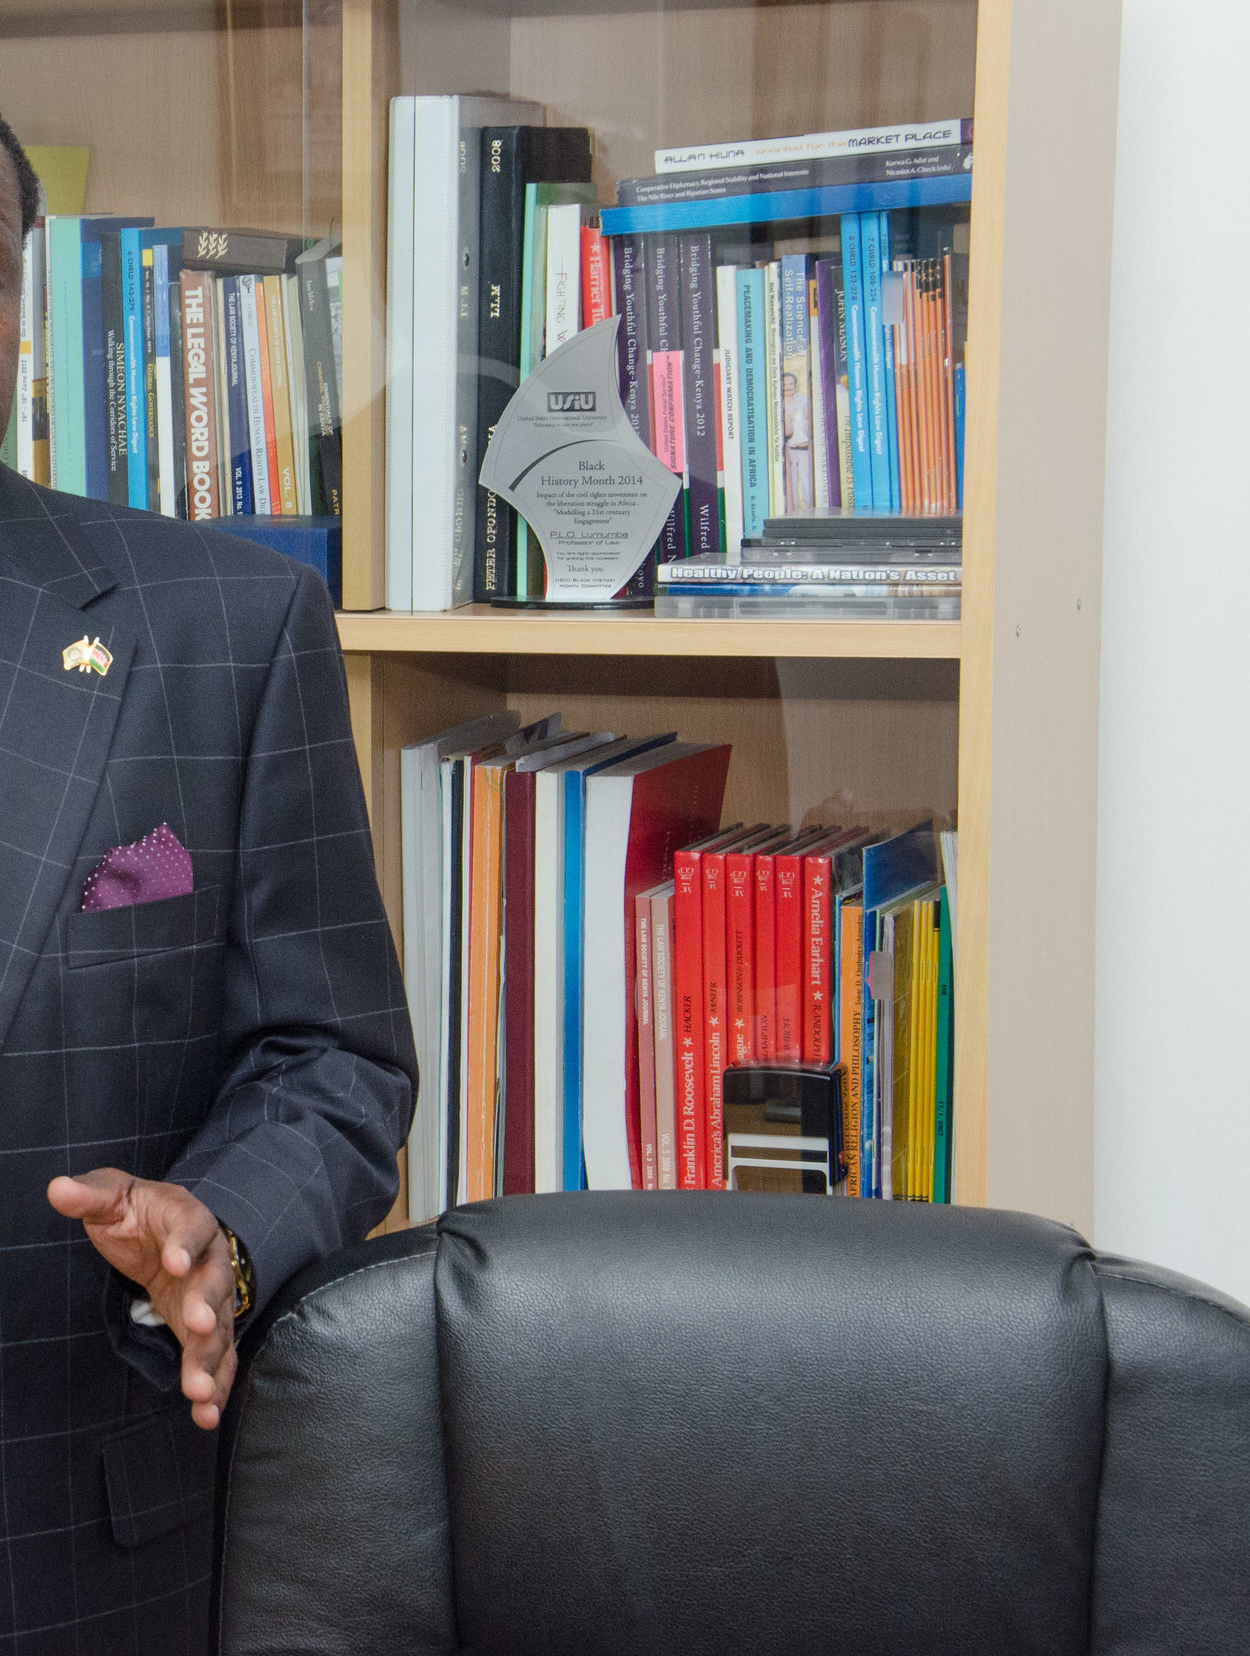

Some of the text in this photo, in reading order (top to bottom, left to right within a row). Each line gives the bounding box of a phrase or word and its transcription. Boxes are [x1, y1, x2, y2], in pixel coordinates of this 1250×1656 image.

[492, 139, 502, 173] 2008
[848, 129, 953, 148] MARKET PLACE
[687, 245, 707, 437] Bridging Youthful Change-Kenya 2012
[784, 269, 795, 359] Self-Realization
[796, 272, 806, 356] The Science of
[834, 289, 848, 362] JOHN MASON
[128, 315, 137, 369] Commonwealth
[107, 330, 119, 471] Walking through the Corridors of Service
[115, 342, 128, 456] SIMEON NYACHAE
[130, 369, 138, 394] Human
[130, 395, 139, 417] Rights
[185, 286, 212, 521] THE LEGAL WORD BOOK
[724, 348, 735, 440] JUDICIARY WATCH REPORT
[743, 285, 758, 488] PEACEMAKING AND DEMOCRATISATION IN AFRICA
[131, 417, 139, 431] Law
[131, 432, 140, 453] Digest
[282, 466, 292, 497] VOL.
[541, 475, 644, 488] History Month 2014
[578, 461, 605, 471] Black
[581, 531, 629, 539] Lumumba
[700, 504, 711, 549] Wilfred
[566, 564, 589, 572] Thank
[671, 566, 957, 581] Healthy People: A Nation's Asset
[811, 887, 825, 1058] Amelia Earhart RANDOLPH
[681, 995, 696, 1185] Franklin D. Roosevelt HACKER
[849, 1010, 862, 1152] RELIGION AND PHILOSOPHY
[708, 1032, 723, 1187] America's Abraham Lincoln
